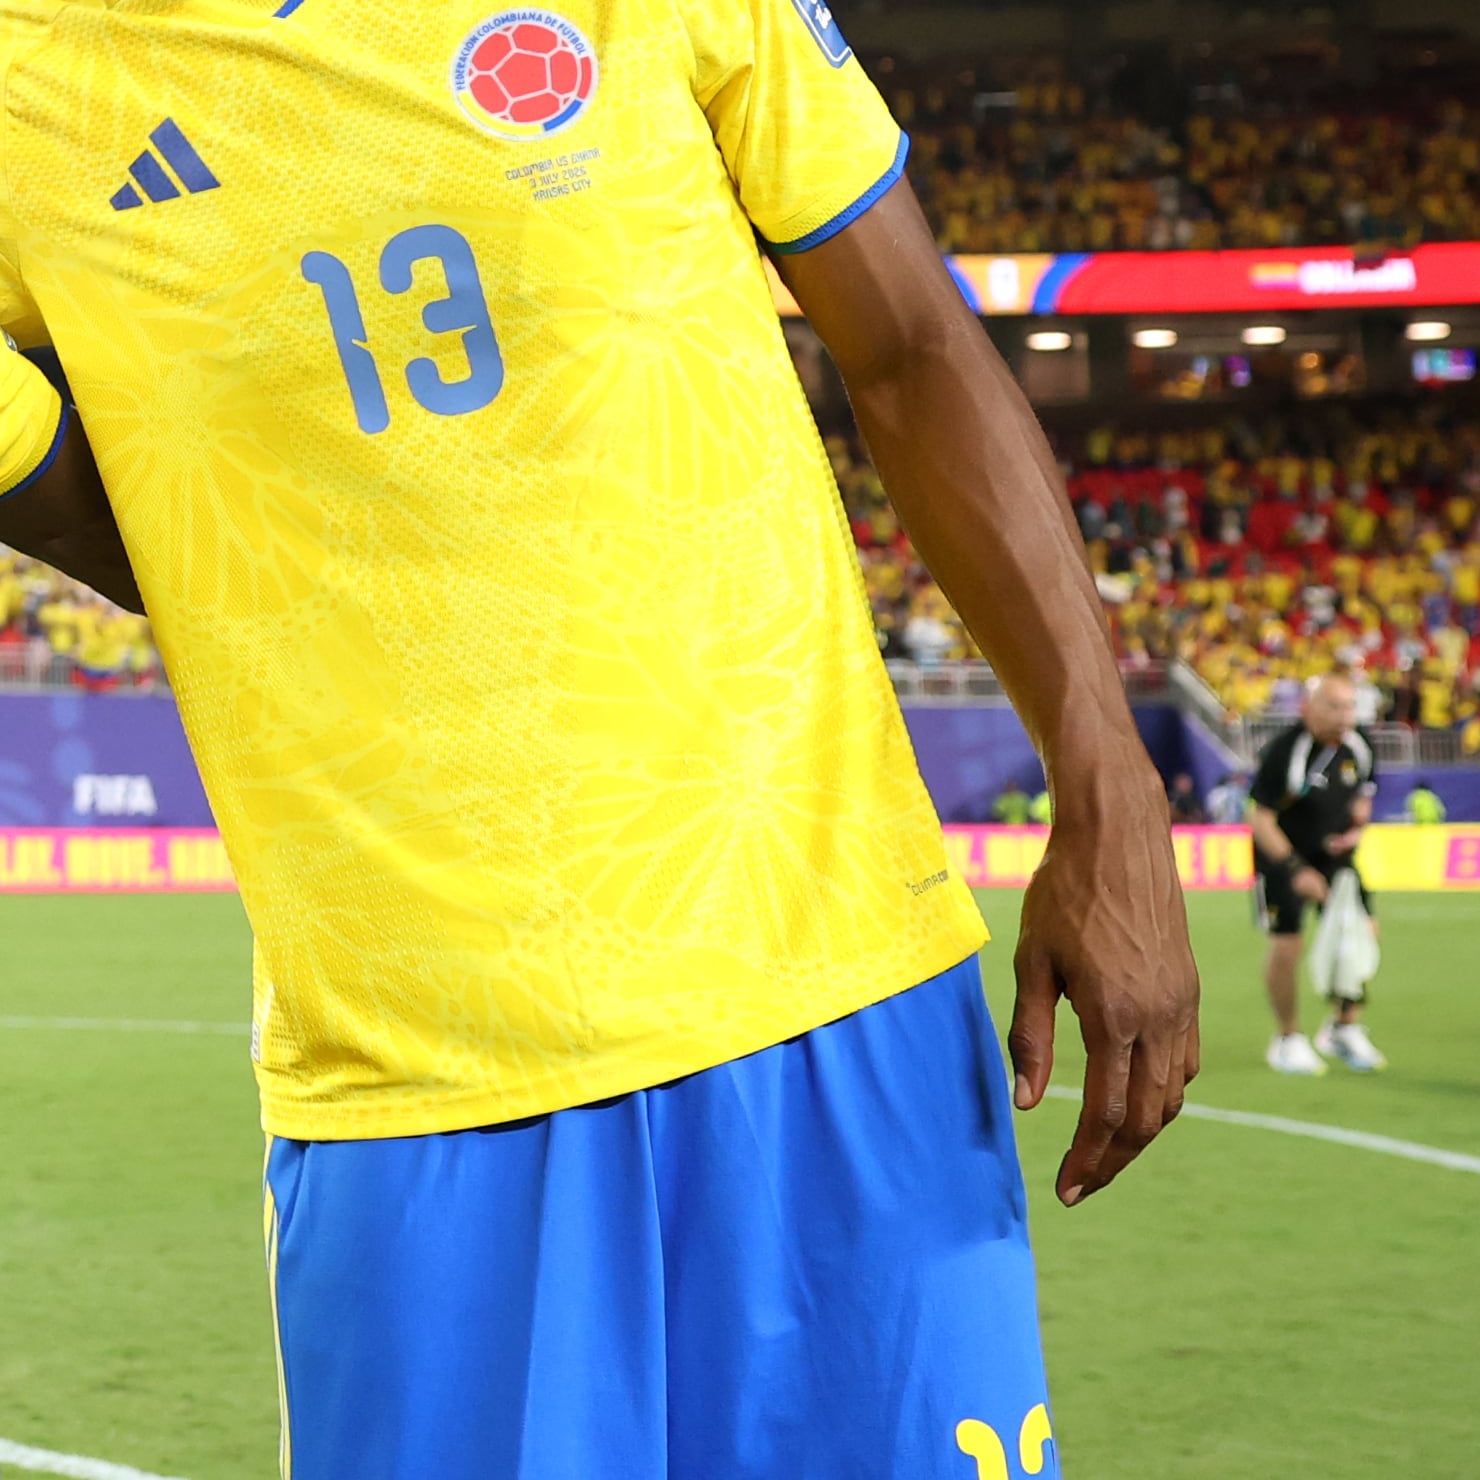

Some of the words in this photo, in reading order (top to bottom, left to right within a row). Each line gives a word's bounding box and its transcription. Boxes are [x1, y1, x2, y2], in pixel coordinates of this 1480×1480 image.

[477, 11, 543, 37] COLOMBIANA
[544, 15, 557, 28] DE
[504, 159, 554, 181] COLOMBIA
[532, 184, 571, 201] KANSAS
[571, 178, 592, 193] CITY
[300, 223, 506, 435] 13
[72, 773, 158, 817] FIFA
